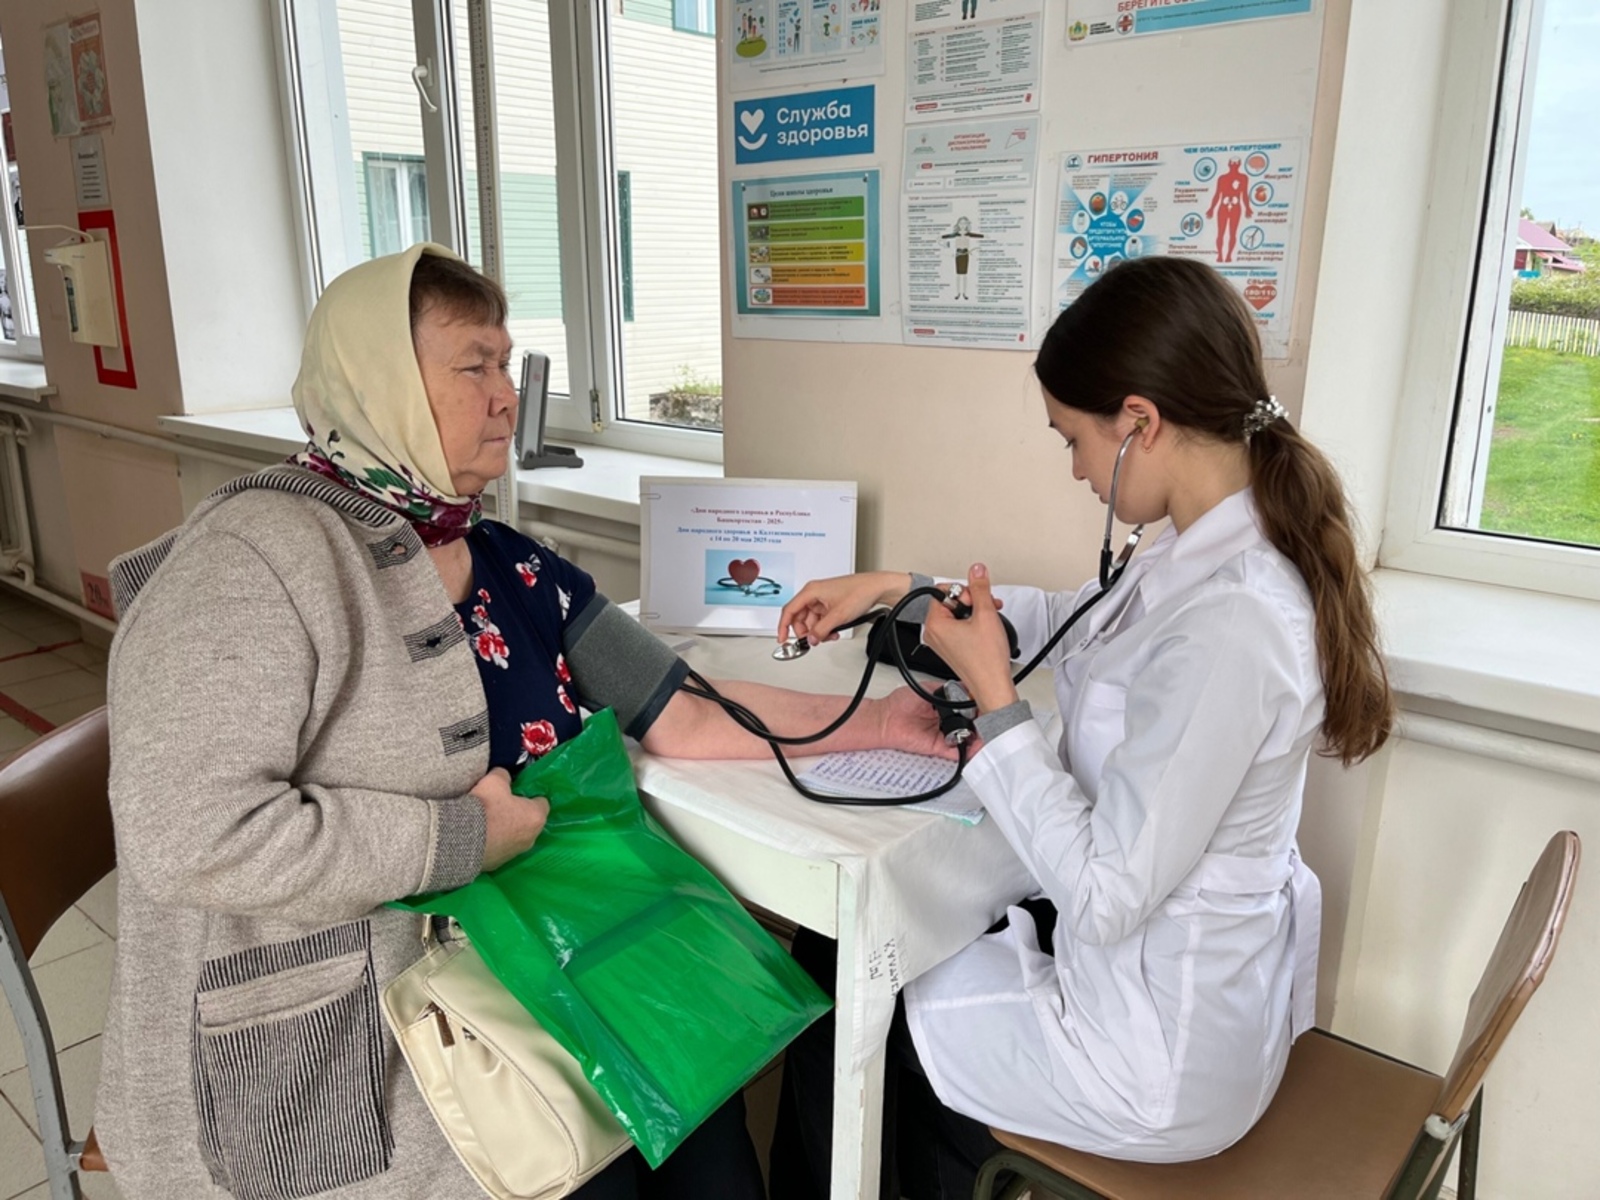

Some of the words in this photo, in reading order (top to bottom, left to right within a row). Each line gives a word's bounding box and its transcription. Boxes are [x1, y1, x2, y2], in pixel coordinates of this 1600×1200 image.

[777, 100, 851, 126] Служба
[777, 124, 868, 146] здоровья
[1087, 151, 1159, 163] ГИПЕРТОНИЯ
[717, 517, 762, 525] Башкортостан
